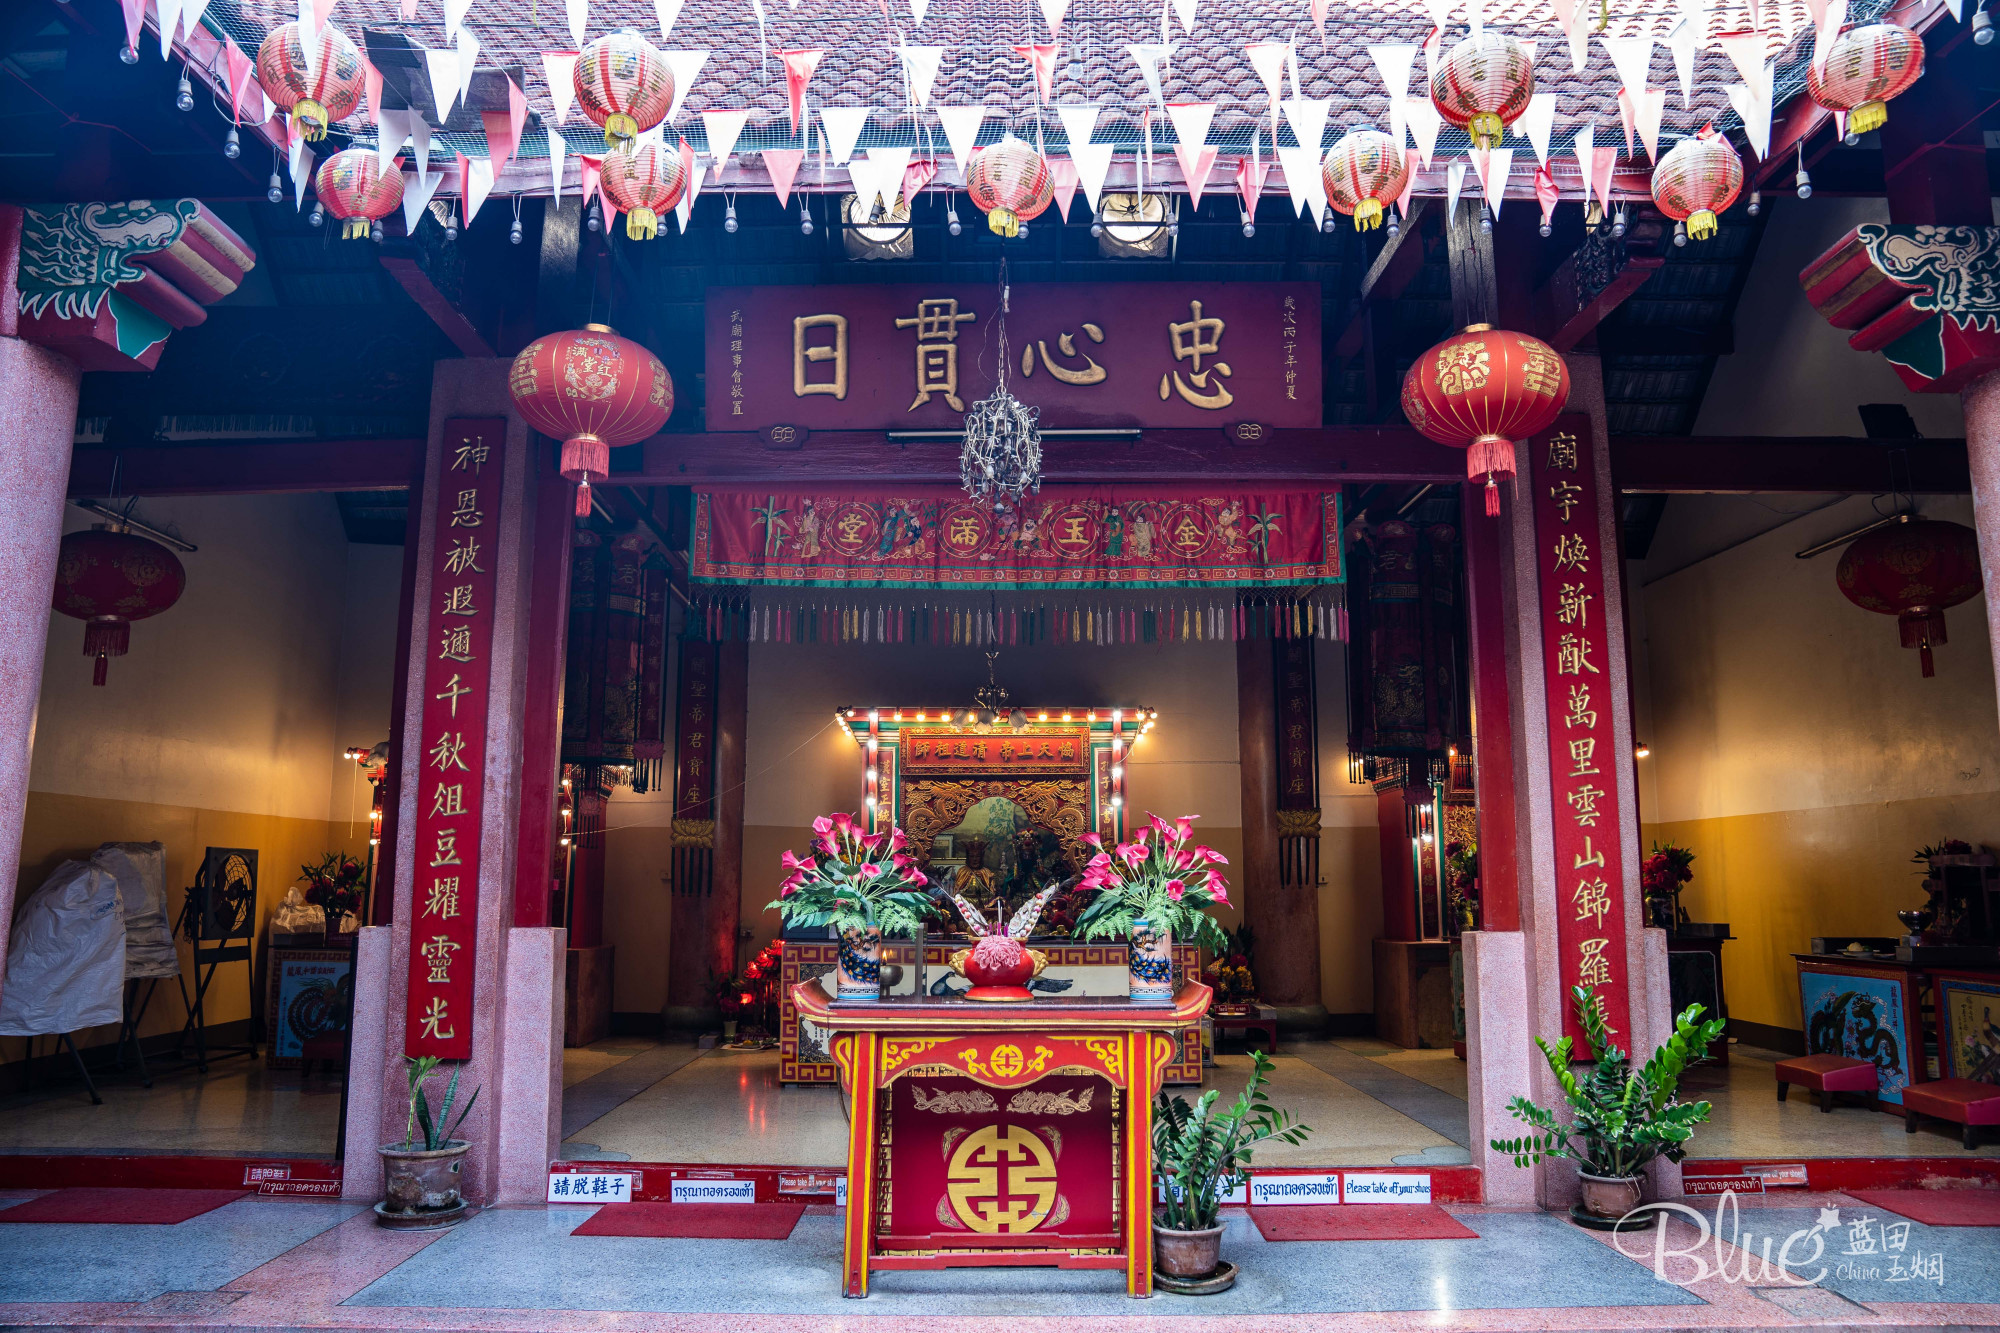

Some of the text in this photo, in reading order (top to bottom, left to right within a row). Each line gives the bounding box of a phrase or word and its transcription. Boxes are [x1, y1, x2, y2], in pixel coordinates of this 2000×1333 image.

[1346, 1179, 1371, 1194] Please
[1388, 1181, 1399, 1194] off
[1398, 1184, 1415, 1197] your
